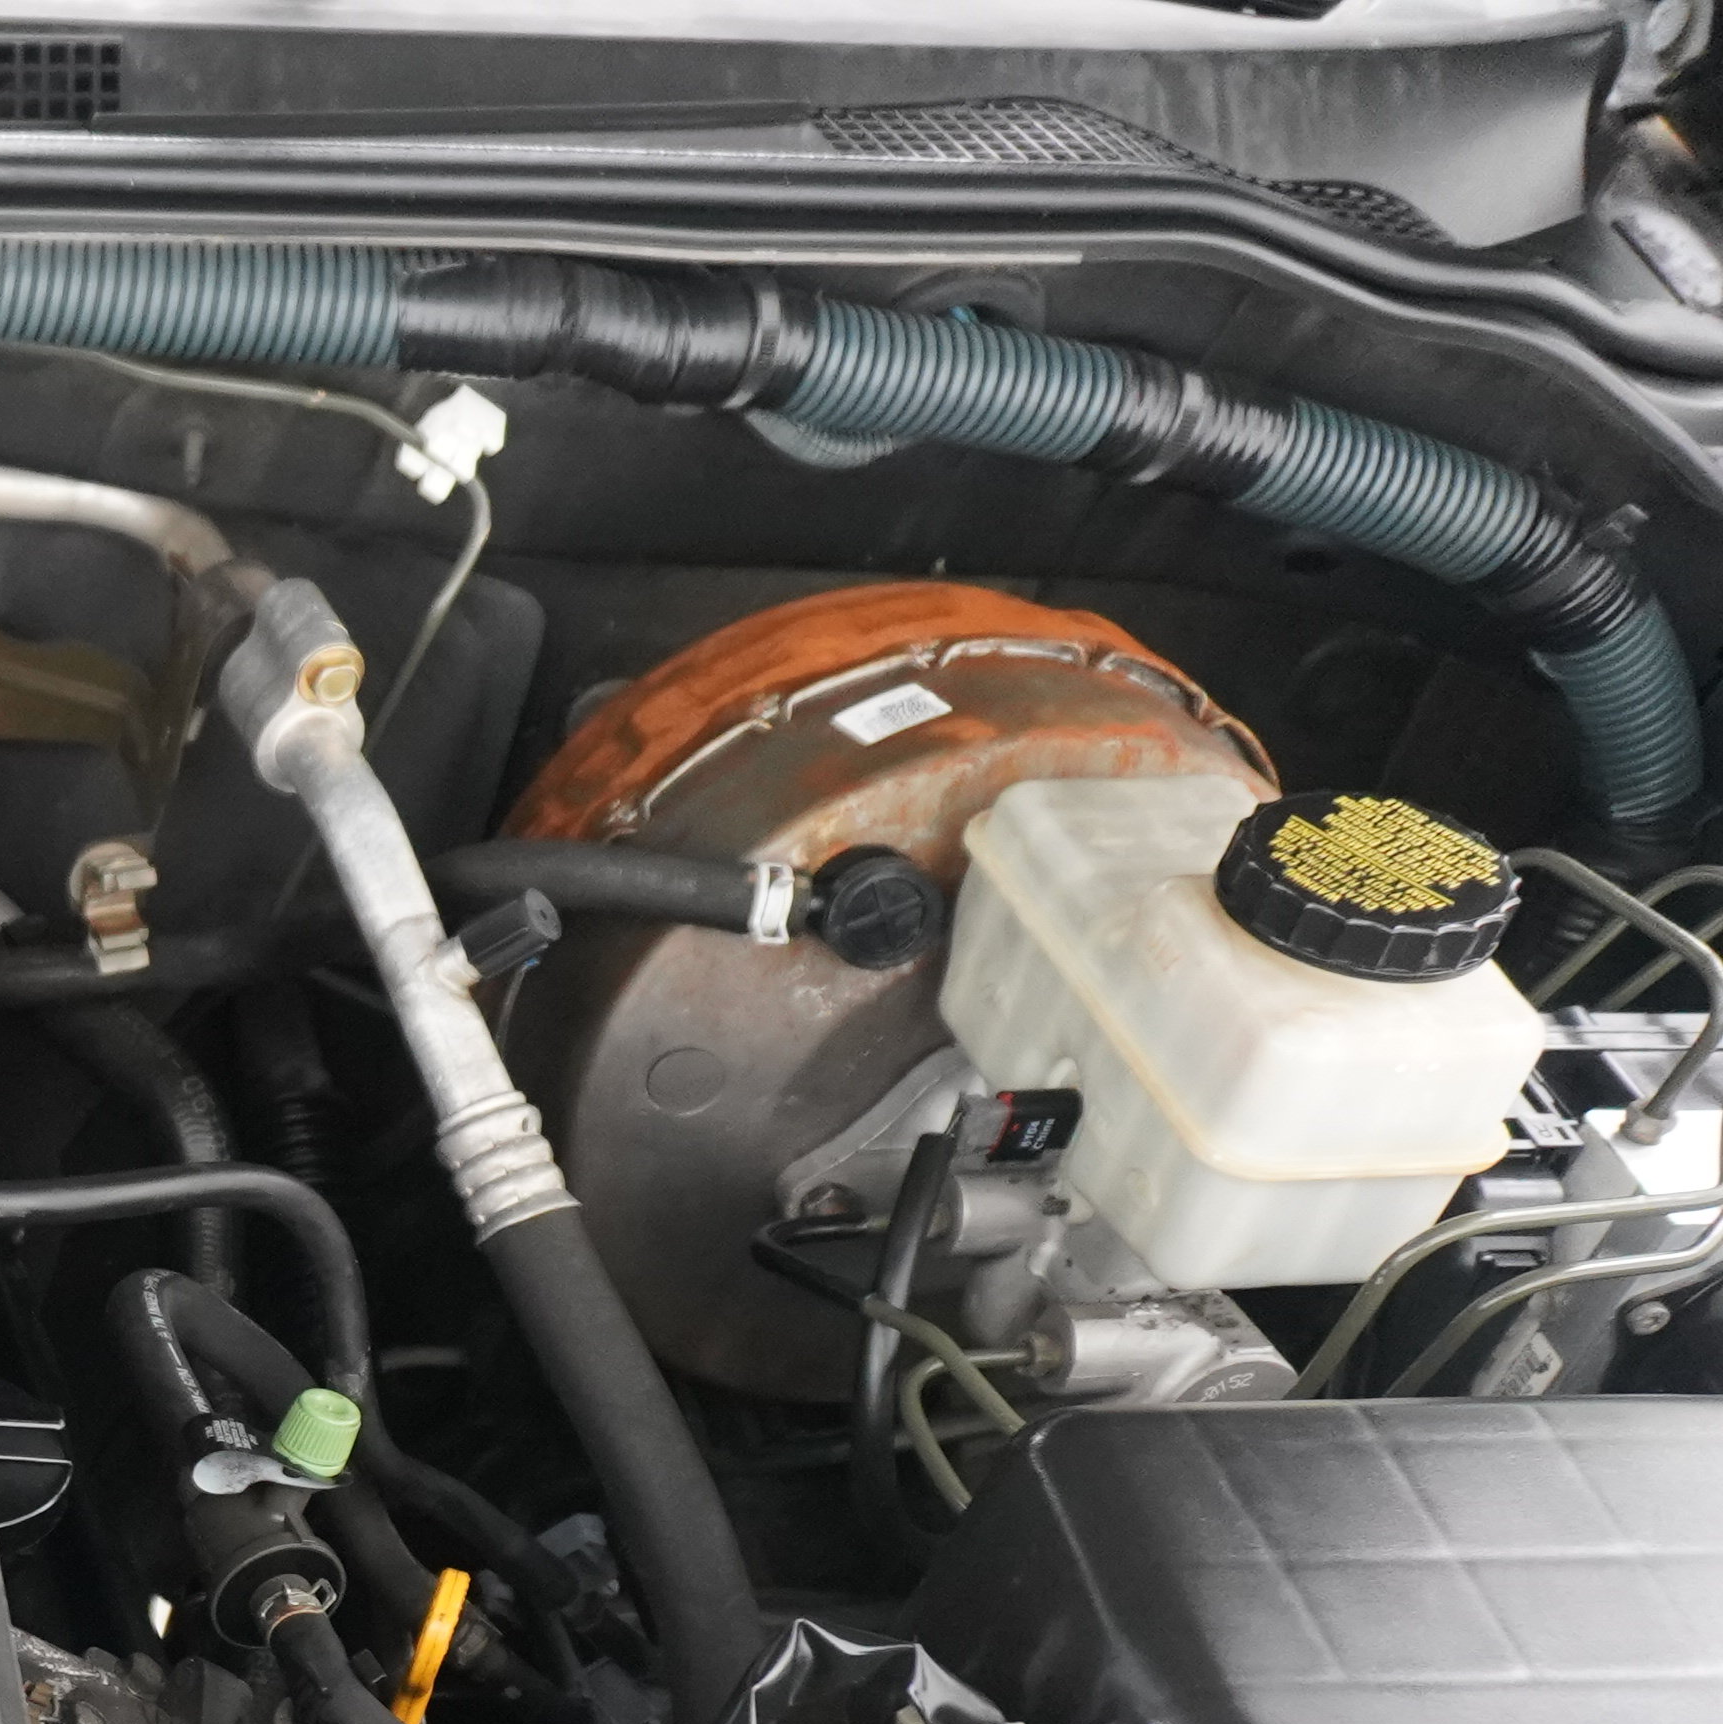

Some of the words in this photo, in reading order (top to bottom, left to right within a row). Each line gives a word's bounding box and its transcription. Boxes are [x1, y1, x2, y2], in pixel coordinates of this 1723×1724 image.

[1272, 826, 1316, 850] FLUID
[1318, 812, 1384, 847] BOUCHON
[1308, 846, 1356, 872] BRAKE
[1345, 855, 1400, 885] SEALED
[1421, 855, 1472, 883] AVANT
[1293, 863, 1342, 889] FILLER
[1331, 884, 1382, 912] CLEAN
[1354, 884, 1408, 914] BEFORE
[1387, 890, 1427, 911] ONLY
[1402, 885, 1448, 910] FROM
[1031, 1118, 1056, 1151] China
